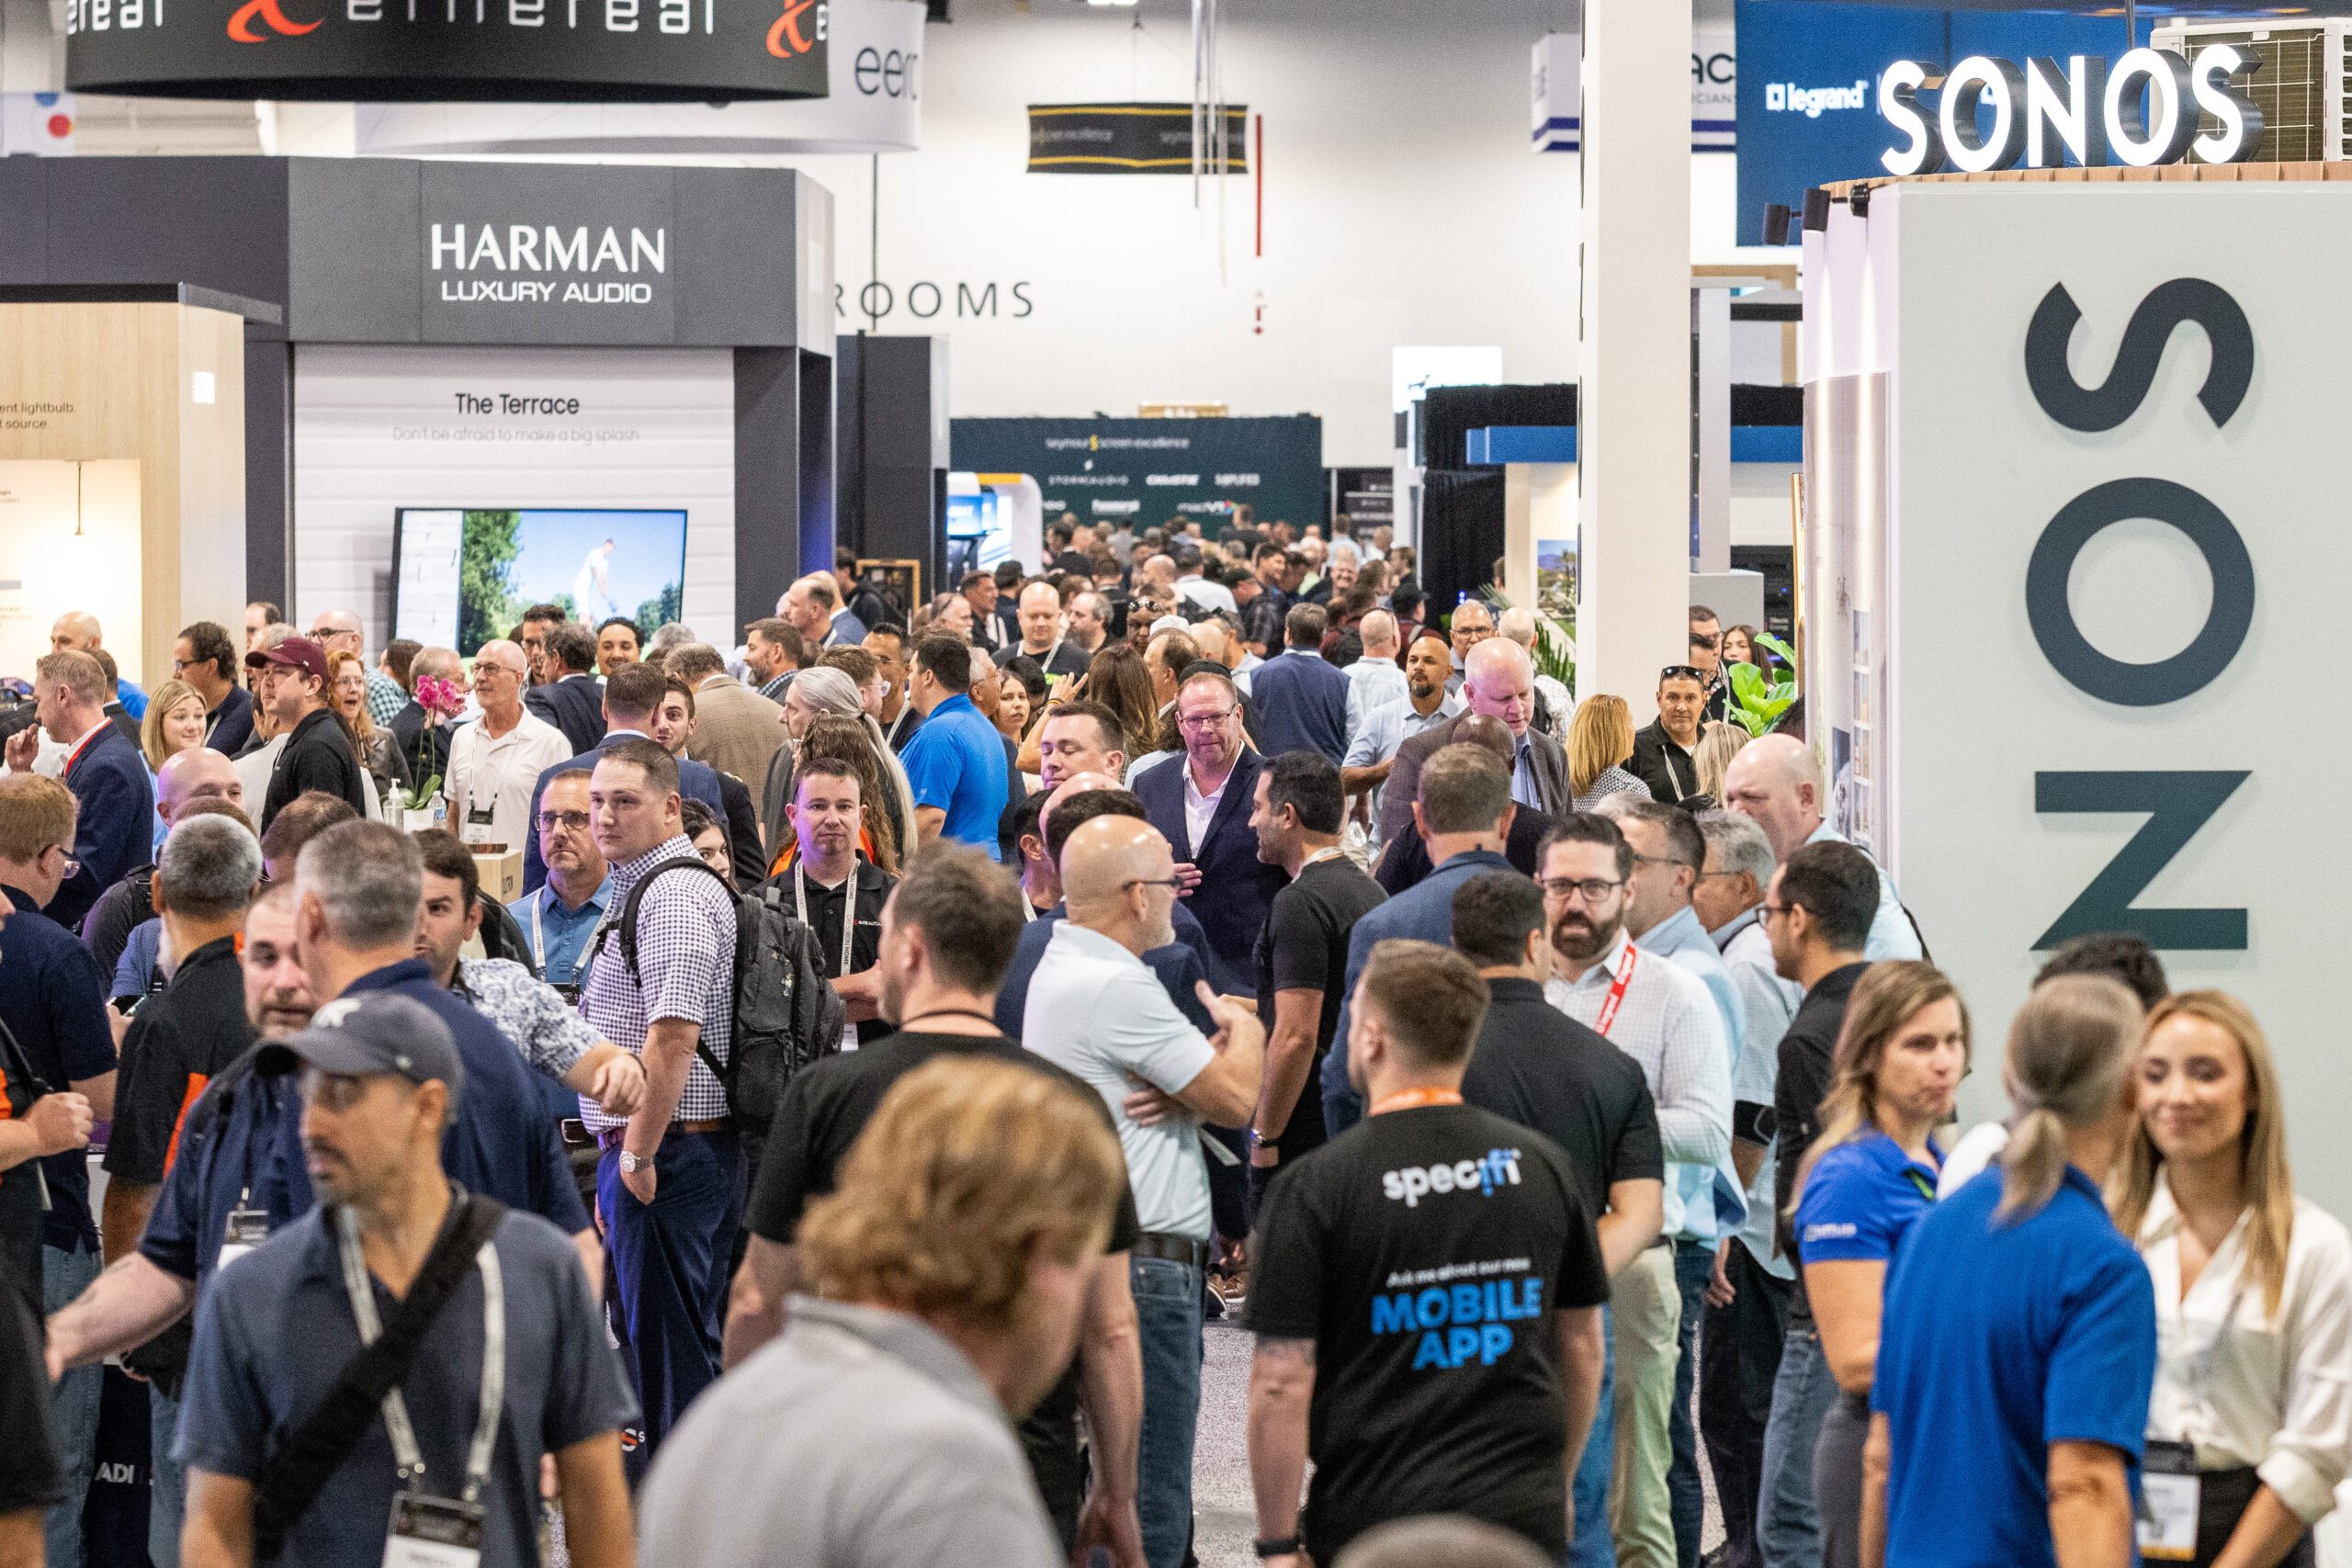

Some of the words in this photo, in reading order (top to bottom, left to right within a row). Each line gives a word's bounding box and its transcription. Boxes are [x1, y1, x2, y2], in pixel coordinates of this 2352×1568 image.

[1787, 80, 1864, 118] legrand
[1880, 43, 2260, 175] SONOS
[431, 223, 665, 273] HARMAN
[442, 280, 557, 301] LUXURY
[562, 282, 651, 303] AUDIO
[455, 393, 493, 414] The
[499, 393, 580, 415] Terrace
[393, 426, 427, 441] Don't
[431, 426, 449, 441] be
[453, 426, 494, 441] afraid
[498, 427, 512, 441] to
[515, 426, 555, 441] make
[559, 430, 568, 441] a
[571, 426, 592, 446] big
[595, 426, 639, 446] splash
[1371, 1277, 1544, 1335] MOBILE
[1411, 1323, 1514, 1371] APP
[95, 1461, 135, 1484] ADI
